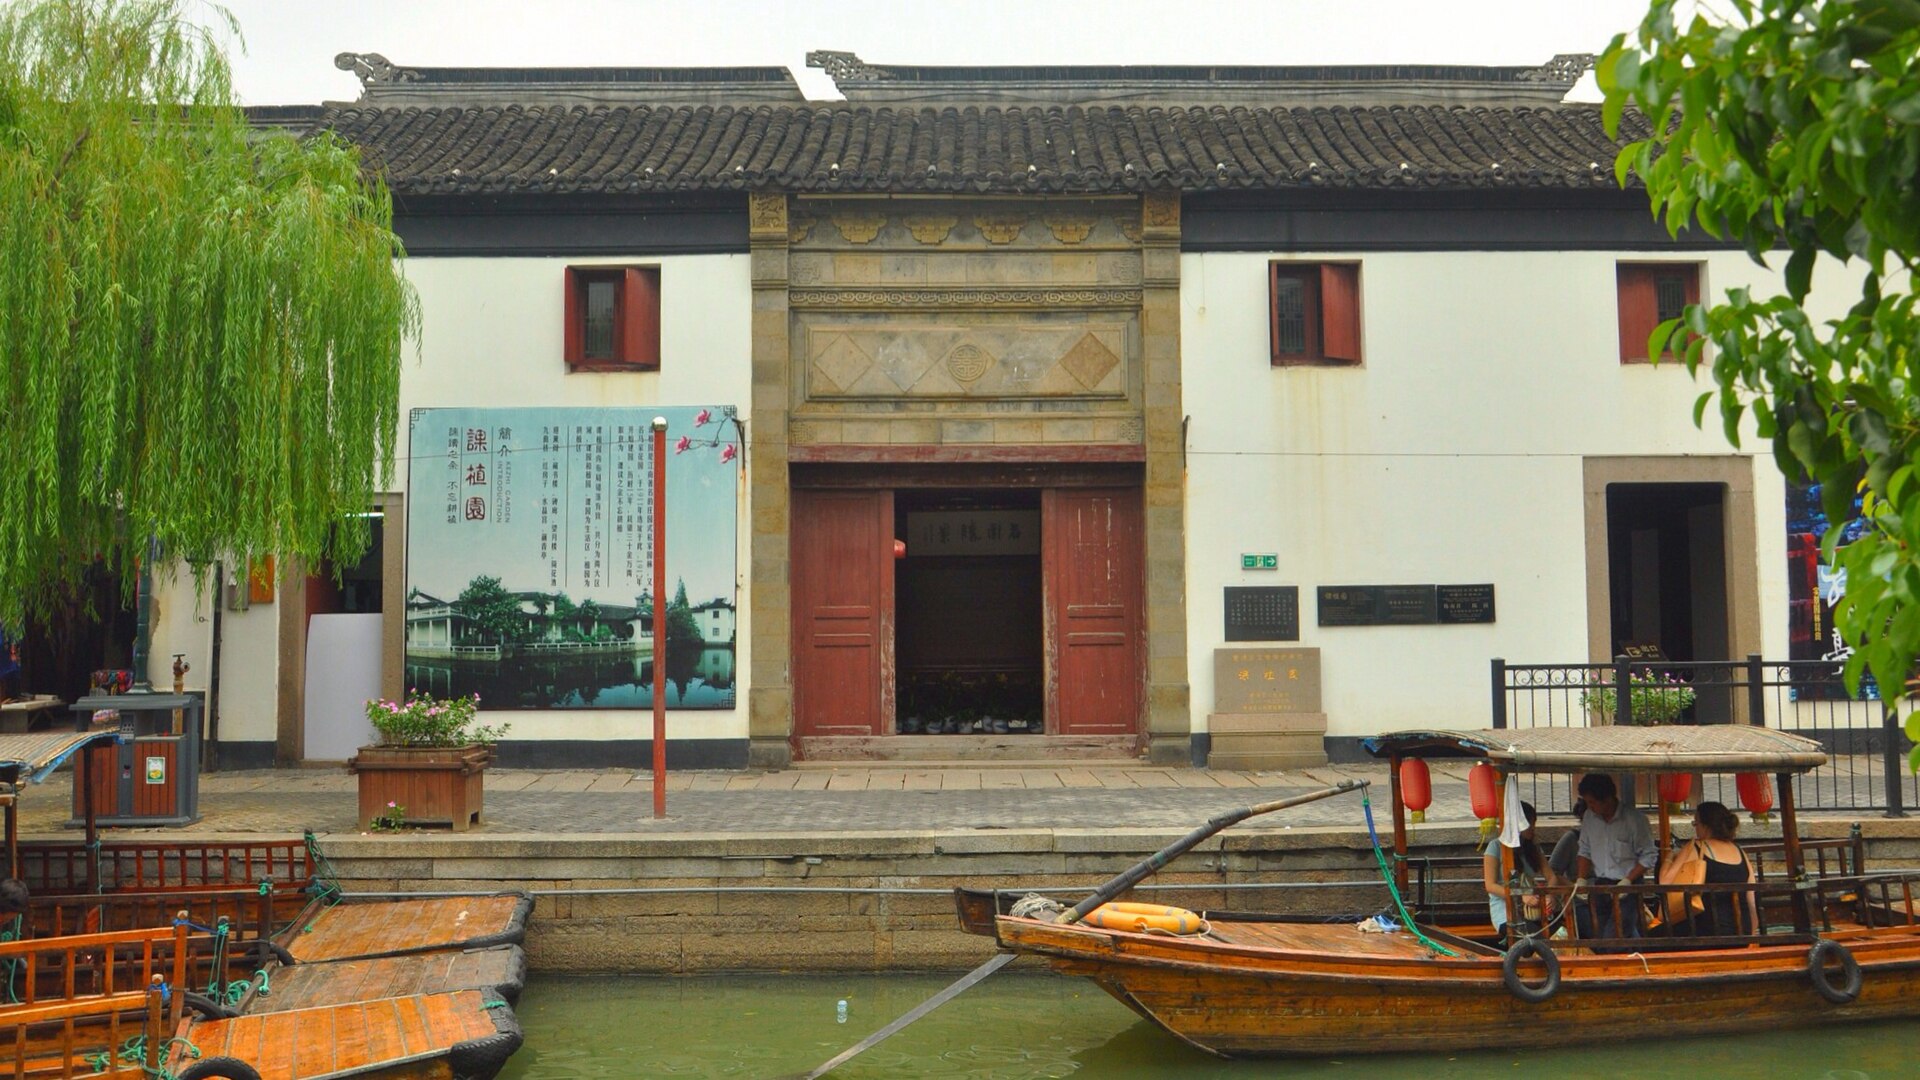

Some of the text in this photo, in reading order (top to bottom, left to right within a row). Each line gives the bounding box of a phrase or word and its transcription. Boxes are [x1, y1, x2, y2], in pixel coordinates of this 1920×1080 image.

[497, 426, 512, 457] 簡介
[465, 428, 487, 521] 課植園
